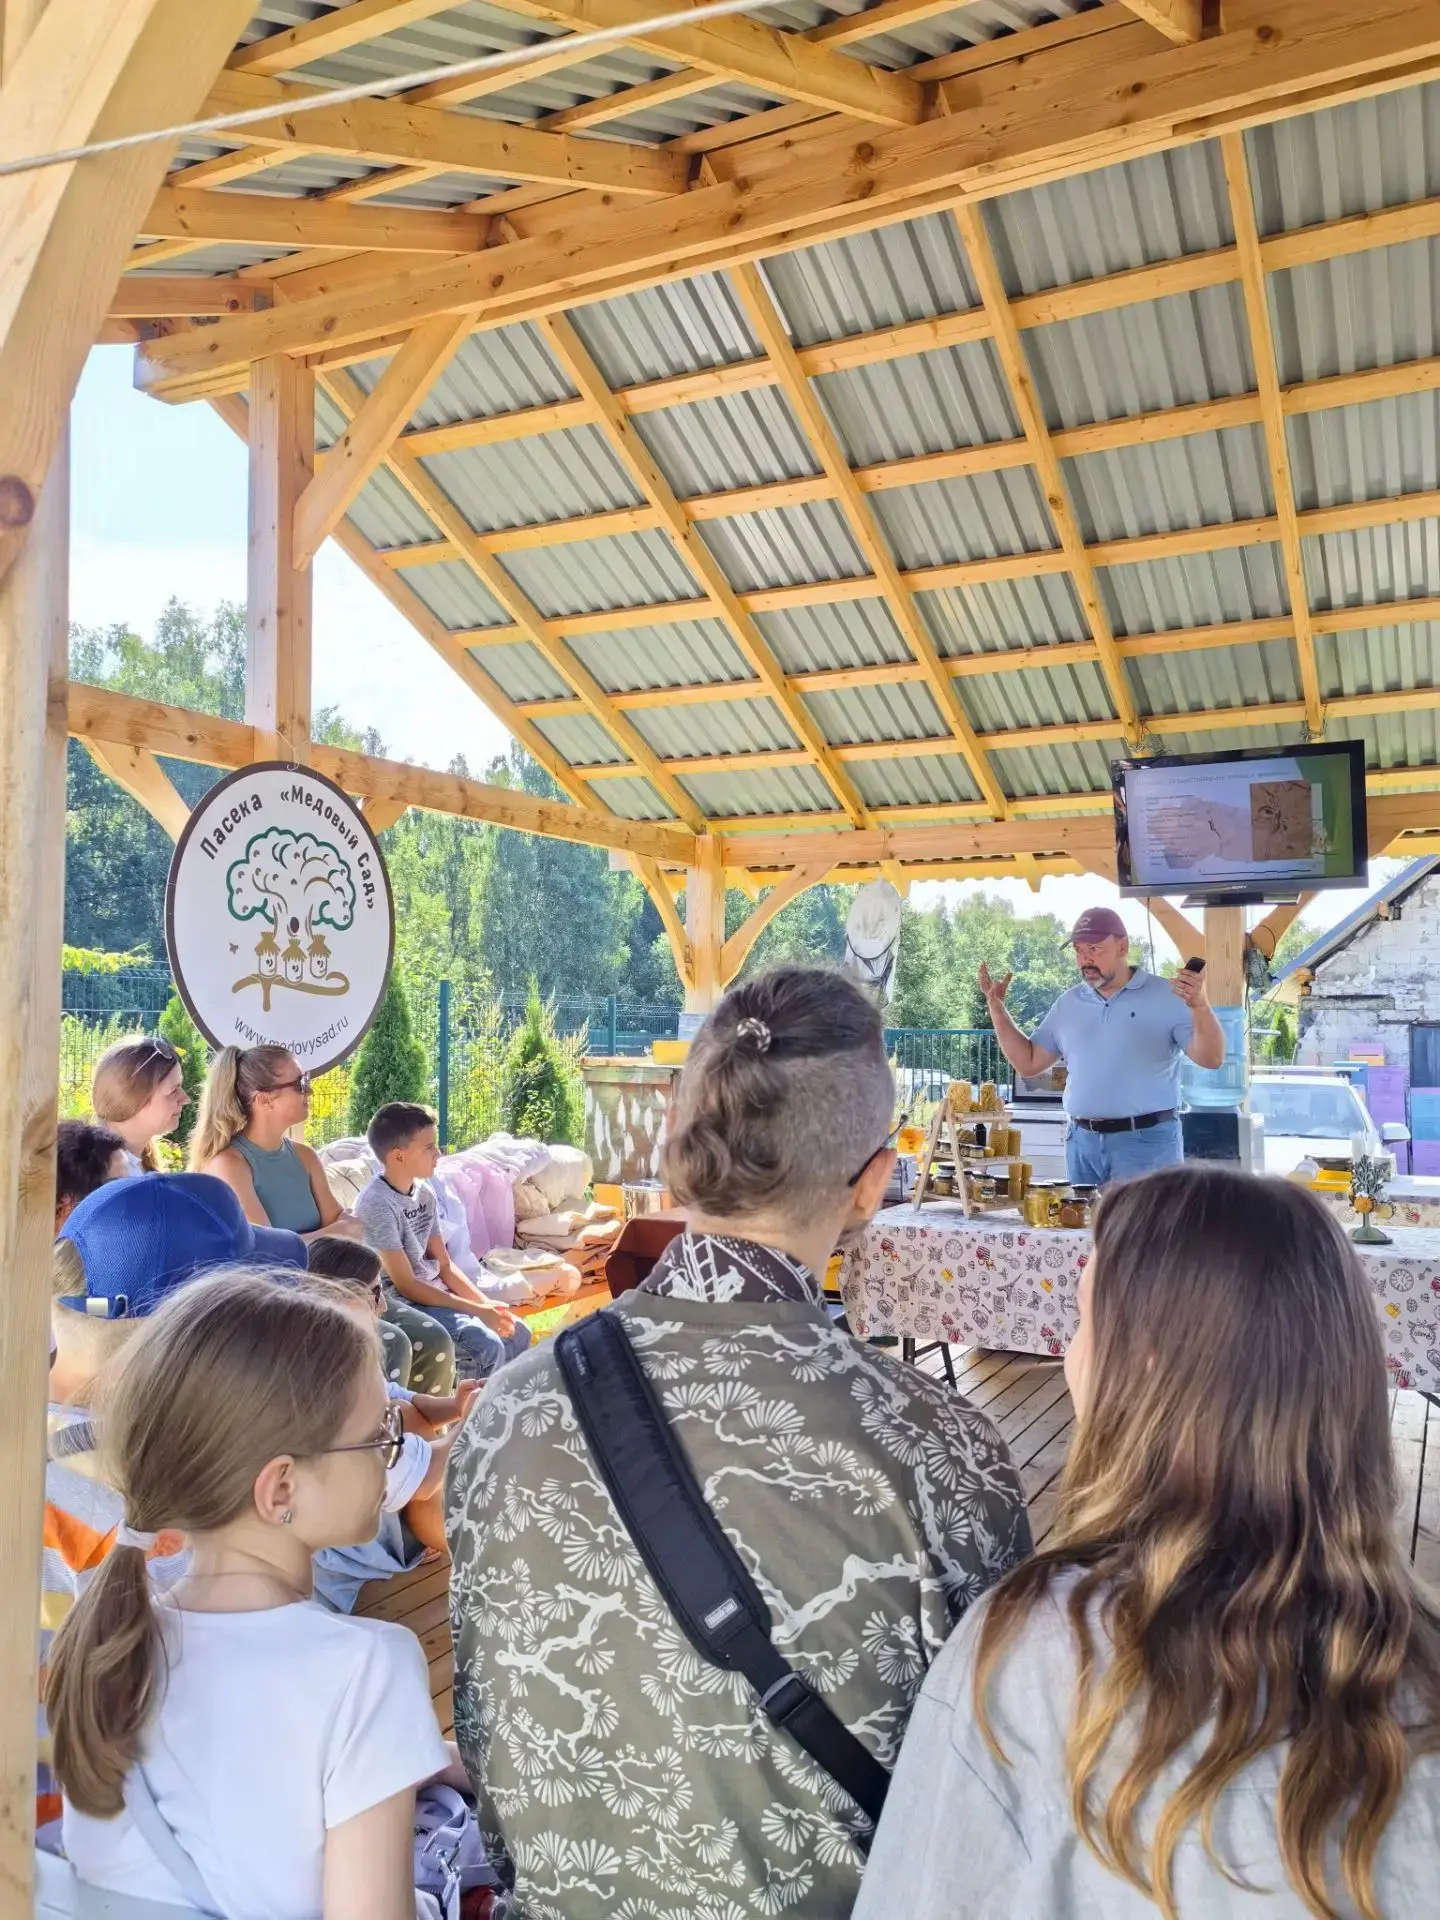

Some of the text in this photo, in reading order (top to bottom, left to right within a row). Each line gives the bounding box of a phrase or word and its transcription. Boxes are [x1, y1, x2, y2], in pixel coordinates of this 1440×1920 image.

[200, 785, 375, 909] Пасека «Медовый Сад»
